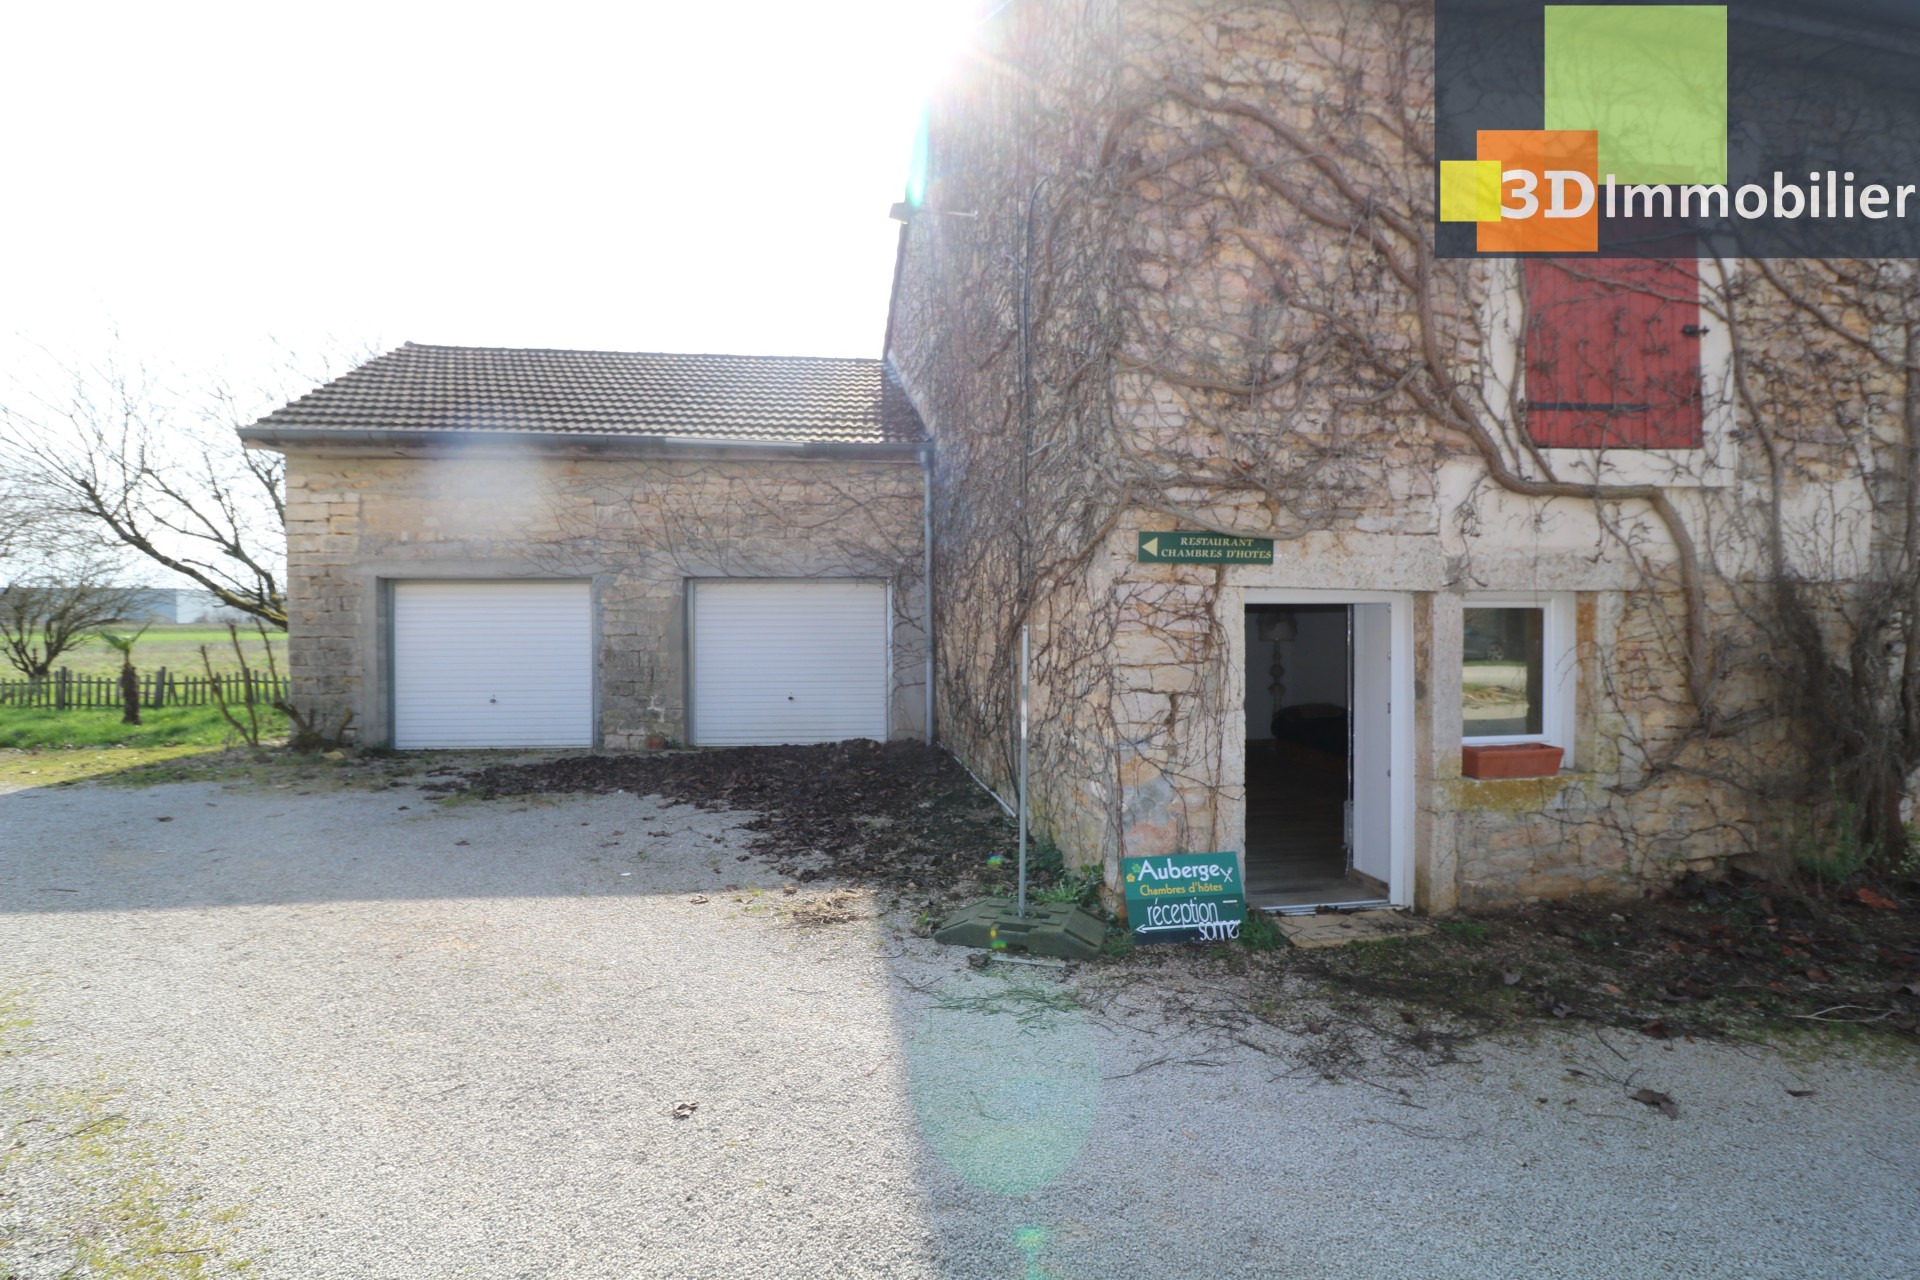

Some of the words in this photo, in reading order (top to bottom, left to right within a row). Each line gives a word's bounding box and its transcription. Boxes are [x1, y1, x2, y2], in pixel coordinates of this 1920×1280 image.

[1180, 537, 1254, 547] RESTAURANT
[1161, 549, 1222, 558] CHAMBRES
[1137, 858, 1220, 882] Auberge
[1139, 883, 1186, 896] Chambres
[1188, 882, 1223, 893] d'hôtes
[1146, 897, 1219, 929] réception
